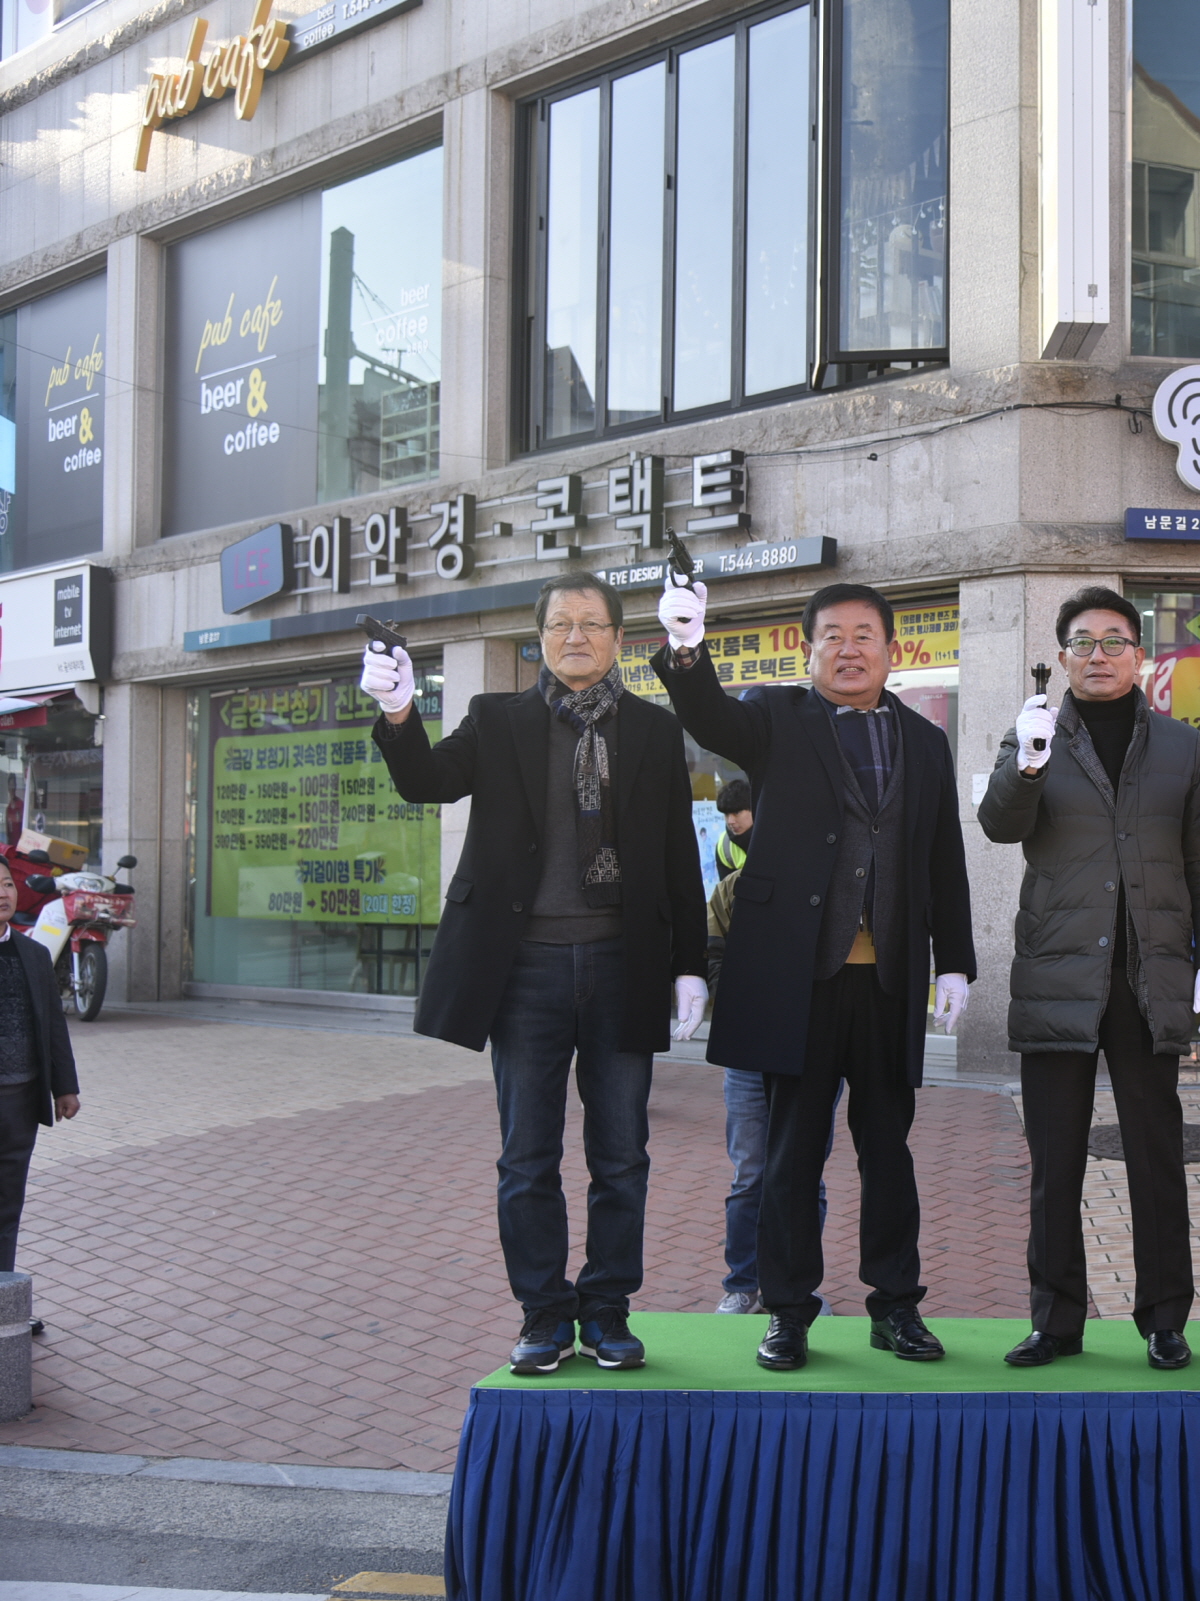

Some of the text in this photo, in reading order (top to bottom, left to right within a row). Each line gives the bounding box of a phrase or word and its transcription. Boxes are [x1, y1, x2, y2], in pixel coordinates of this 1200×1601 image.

[317, 4, 335, 20] beer
[303, 23, 335, 46] coffee
[134, 0, 290, 172] pub cafe
[400, 283, 430, 307] beer
[195, 275, 283, 374] pub cafe
[376, 315, 428, 347] coffee
[45, 333, 103, 407] pub cafe
[201, 368, 268, 417] beer &
[48, 407, 94, 444] beer &
[224, 422, 280, 455] coffee
[64, 447, 102, 472] coffee
[1144, 515, 1187, 531] 남문길
[234, 548, 270, 590] LEE
[719, 545, 797, 573] T.544-8880
[609, 570, 628, 586] EYE
[57, 584, 80, 602] mobile
[64, 605, 72, 618] tv
[55, 623, 82, 639] internet
[740, 655, 796, 682] 콘택트
[271, 685, 329, 726] 보청기
[256, 743, 289, 769] 보청기
[331, 740, 367, 766] 전품목
[299, 773, 339, 797] 100만원
[341, 776, 375, 796] 150만원
[268, 892, 302, 914] 80만원
[321, 889, 360, 916] 50만원
